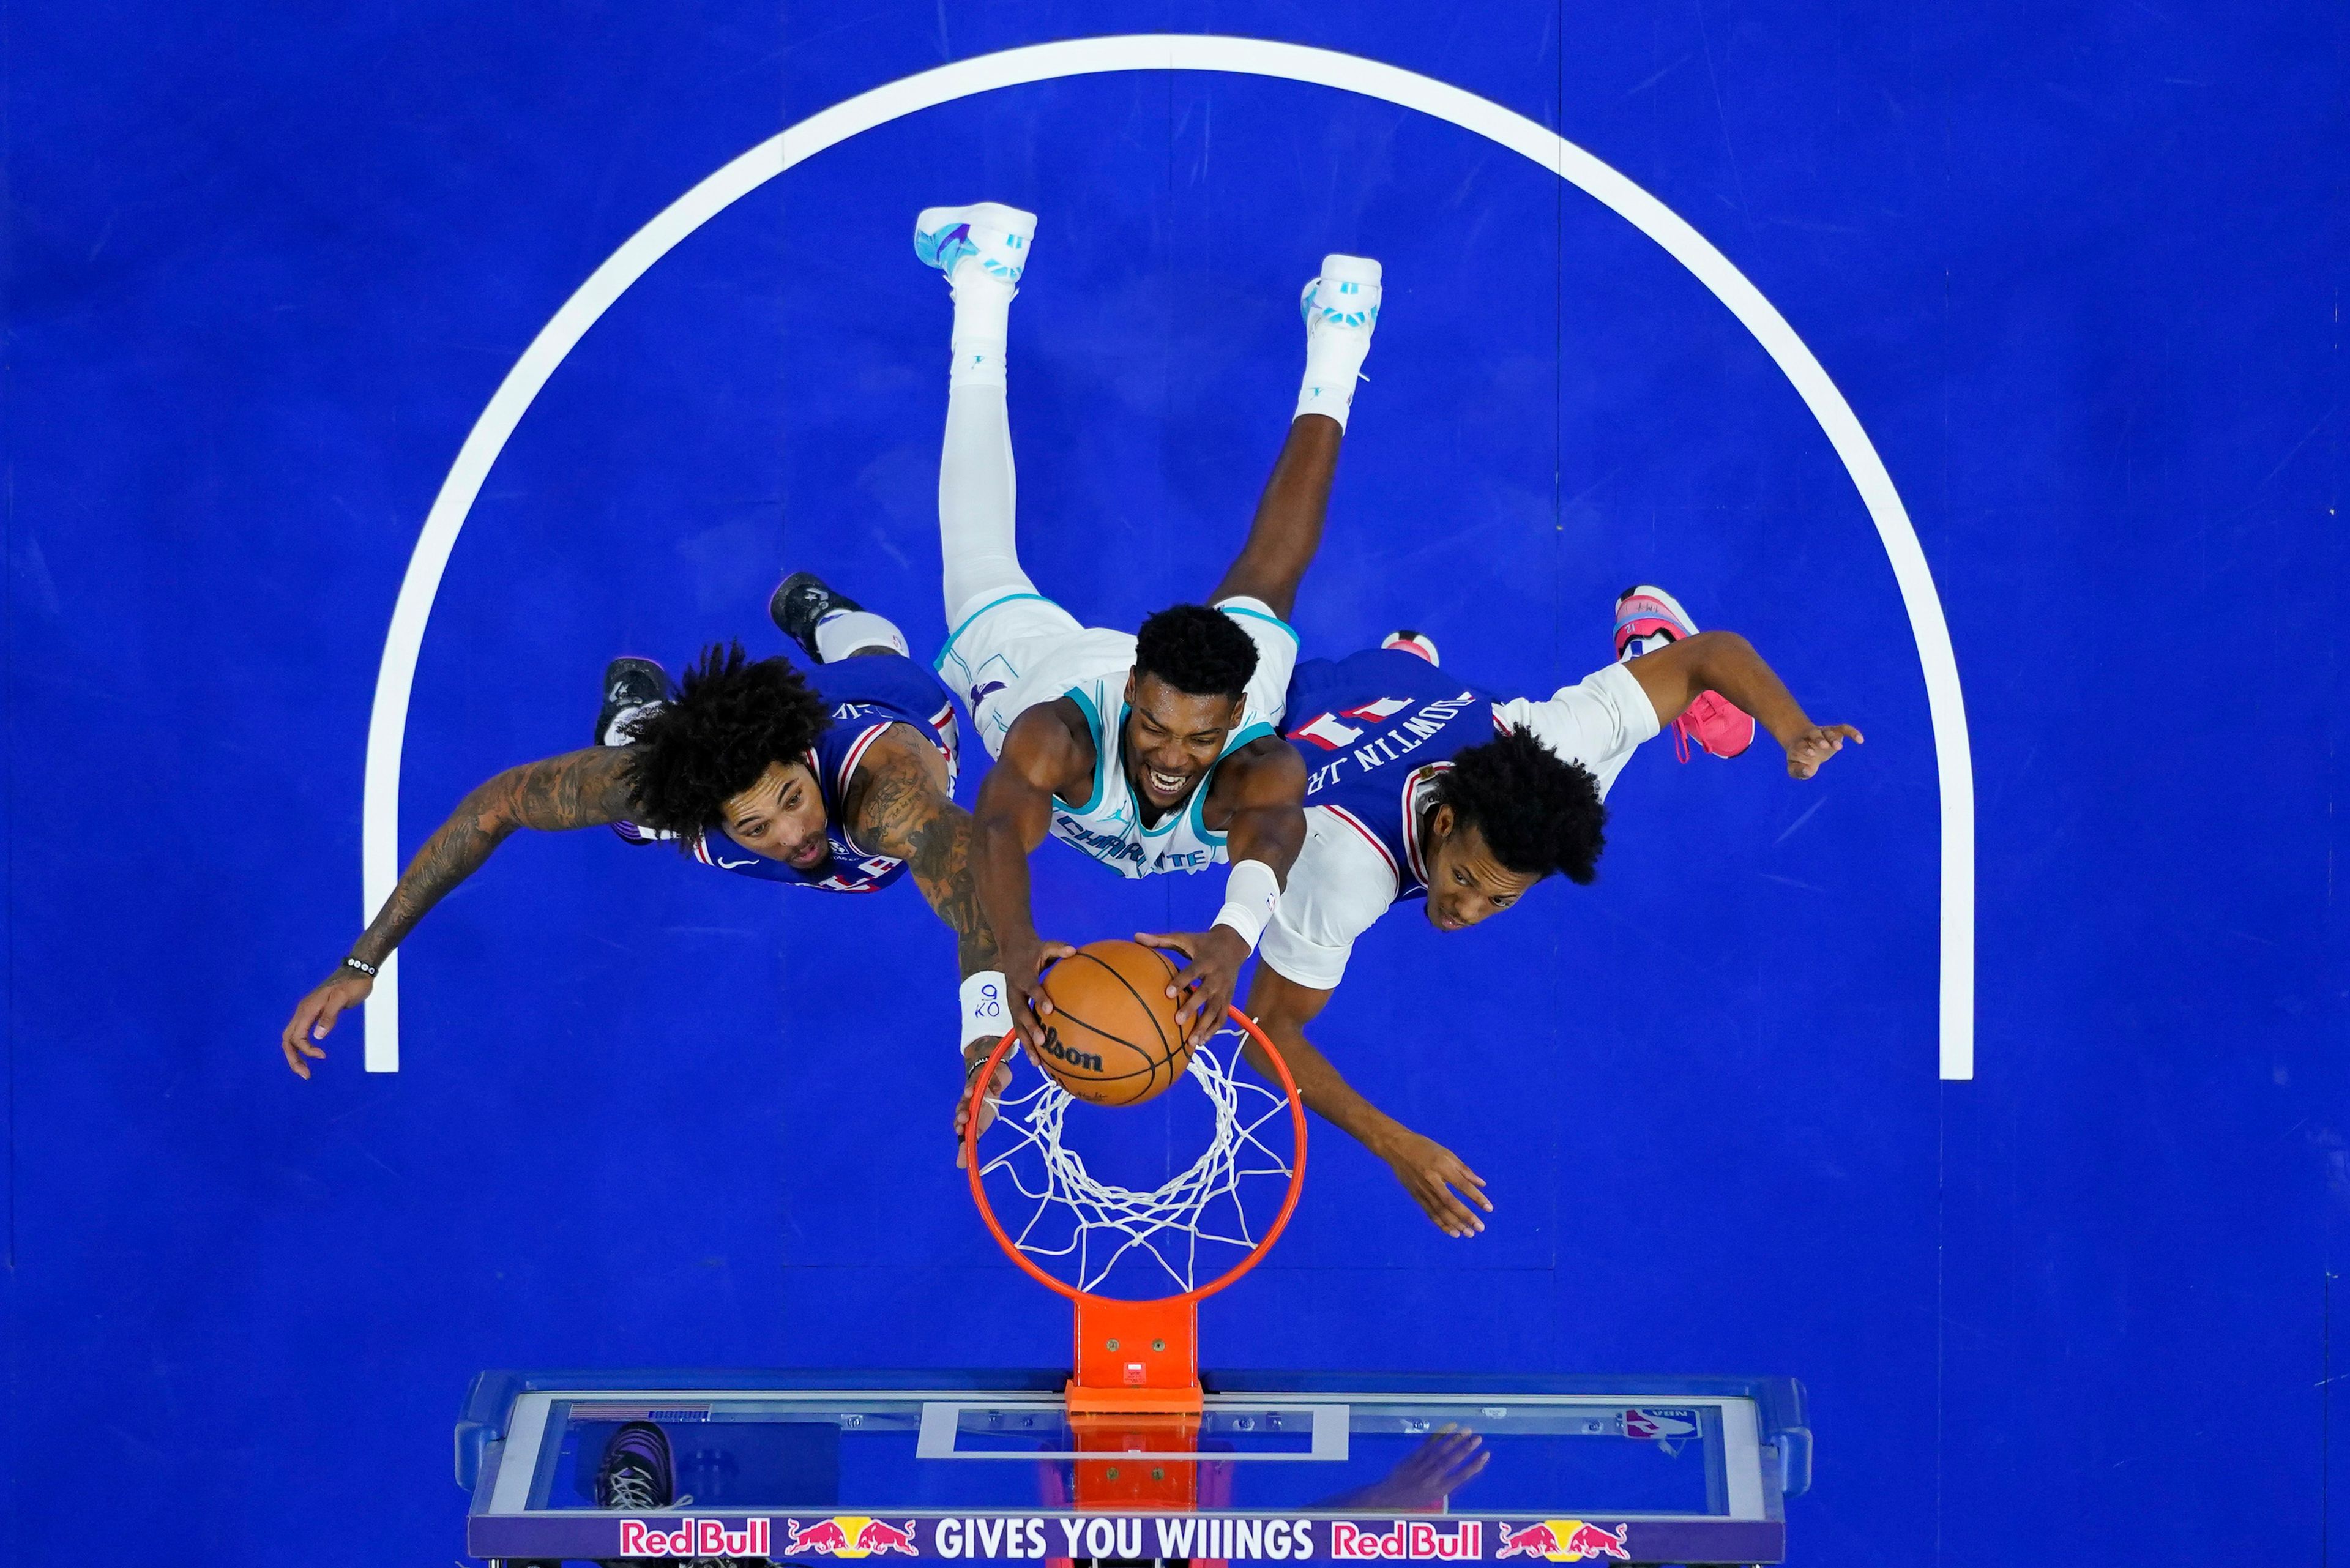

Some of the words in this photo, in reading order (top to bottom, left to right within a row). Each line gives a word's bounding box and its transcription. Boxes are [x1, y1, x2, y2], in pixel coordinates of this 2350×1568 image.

[1286, 696, 1416, 752] 11
[1307, 757, 1348, 796] JR
[974, 1001, 1000, 1018] KO
[981, 984, 998, 1000] 9
[621, 1518, 695, 1556] Red
[698, 1518, 770, 1556] Bull
[935, 1518, 1047, 1559] GIVES
[1060, 1518, 1141, 1559] YOU
[1155, 1518, 1314, 1560] WIIINGS
[1332, 1520, 1406, 1559] Red
[1409, 1521, 1482, 1560] Bull
